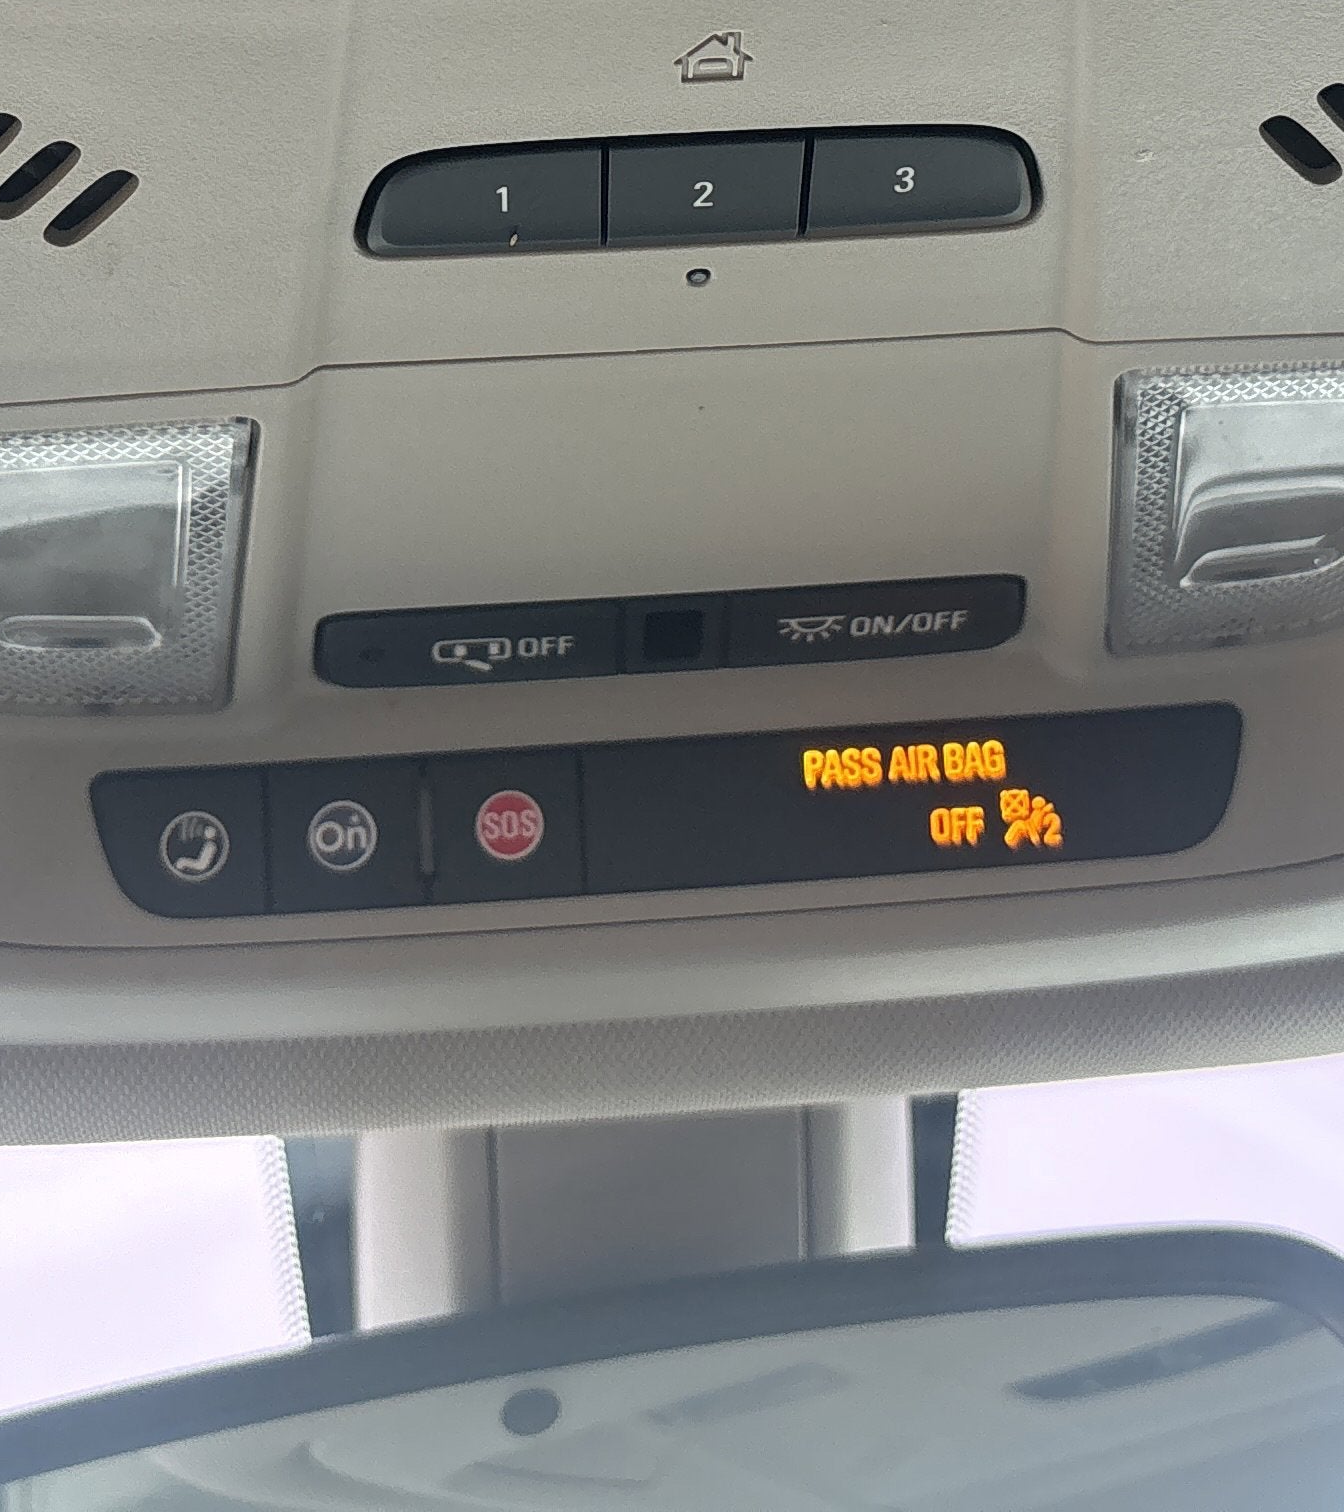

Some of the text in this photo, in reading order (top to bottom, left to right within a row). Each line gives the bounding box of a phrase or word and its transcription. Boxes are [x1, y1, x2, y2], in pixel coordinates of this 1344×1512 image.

[893, 166, 915, 193] 3
[495, 186, 511, 213] 1
[692, 181, 714, 208] 2
[849, 609, 969, 638] ON/OFF
[517, 635, 575, 658] OFF
[803, 739, 1006, 789] PASS AIR BAG
[315, 816, 368, 853] On
[484, 810, 536, 840] SOS
[929, 805, 985, 847] OFF
